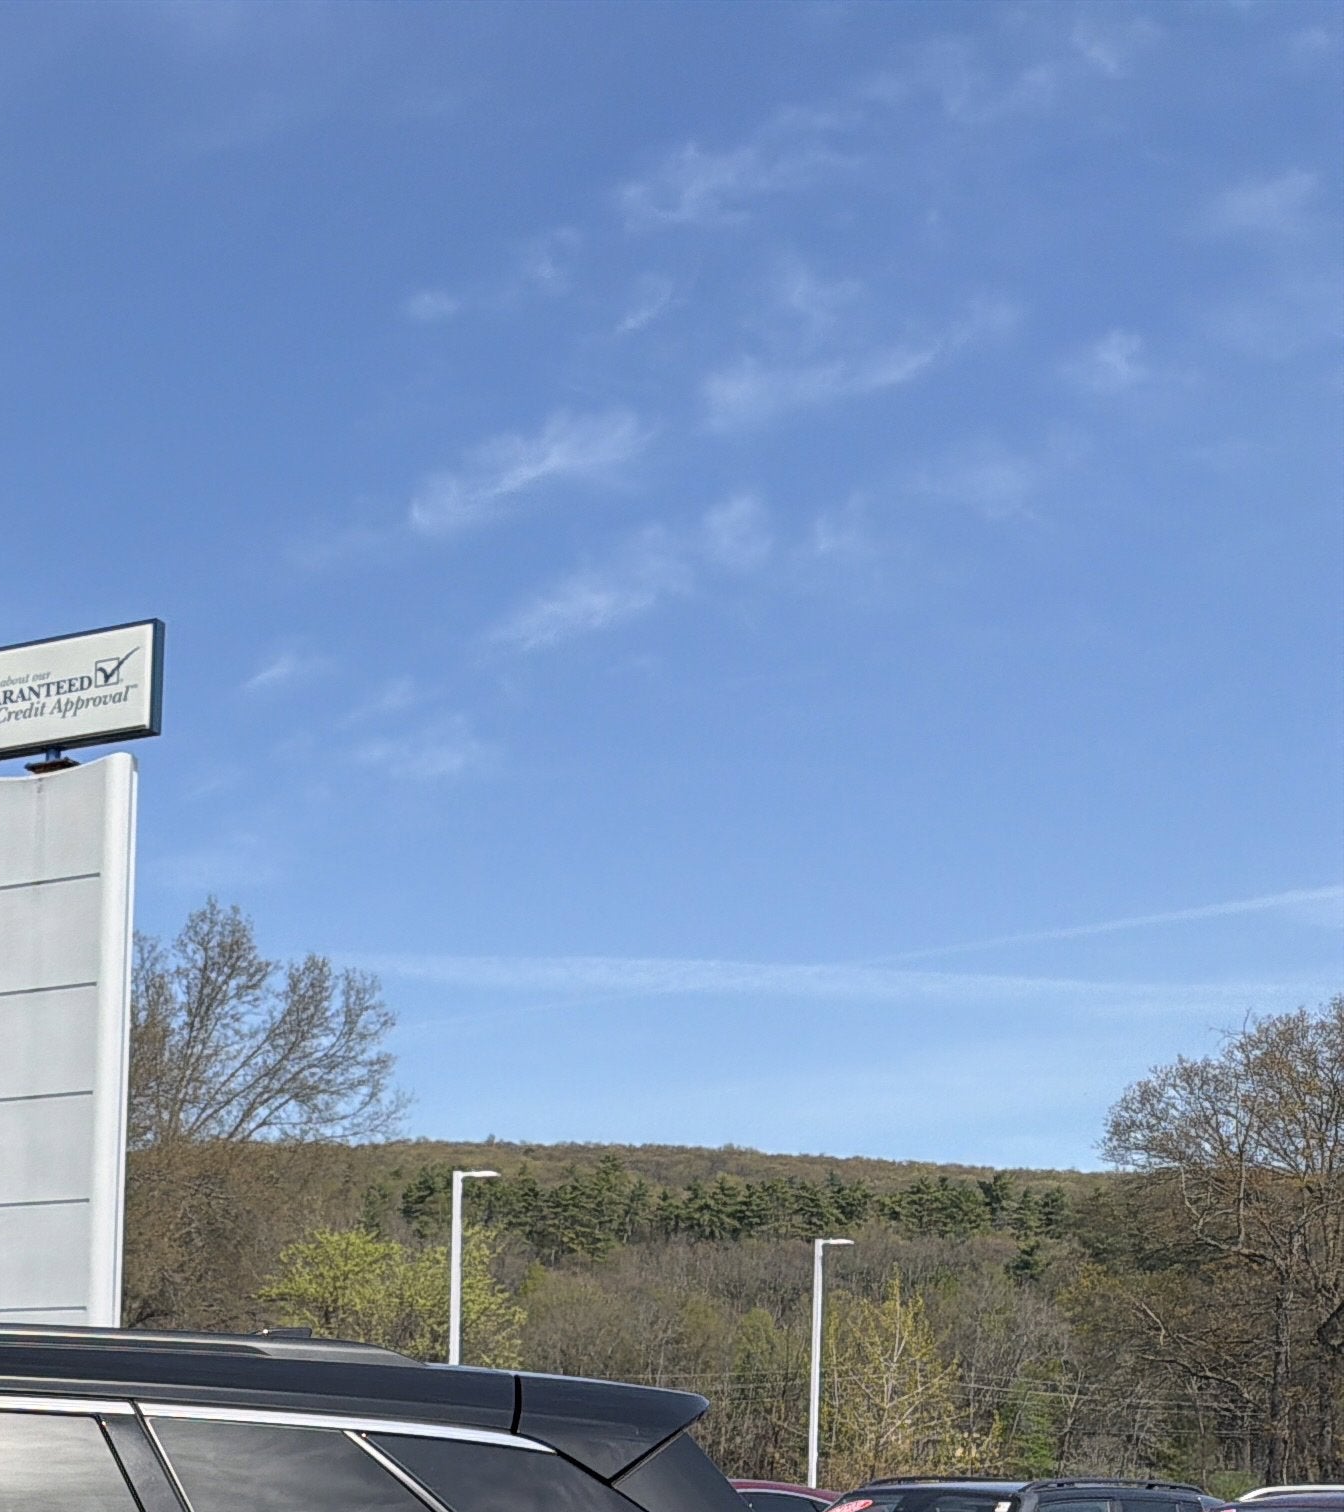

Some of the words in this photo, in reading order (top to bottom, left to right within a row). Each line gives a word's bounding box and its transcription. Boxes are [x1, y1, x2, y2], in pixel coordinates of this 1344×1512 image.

[0, 674, 30, 688] about
[31, 671, 52, 682] our
[49, 685, 130, 720] Approval
